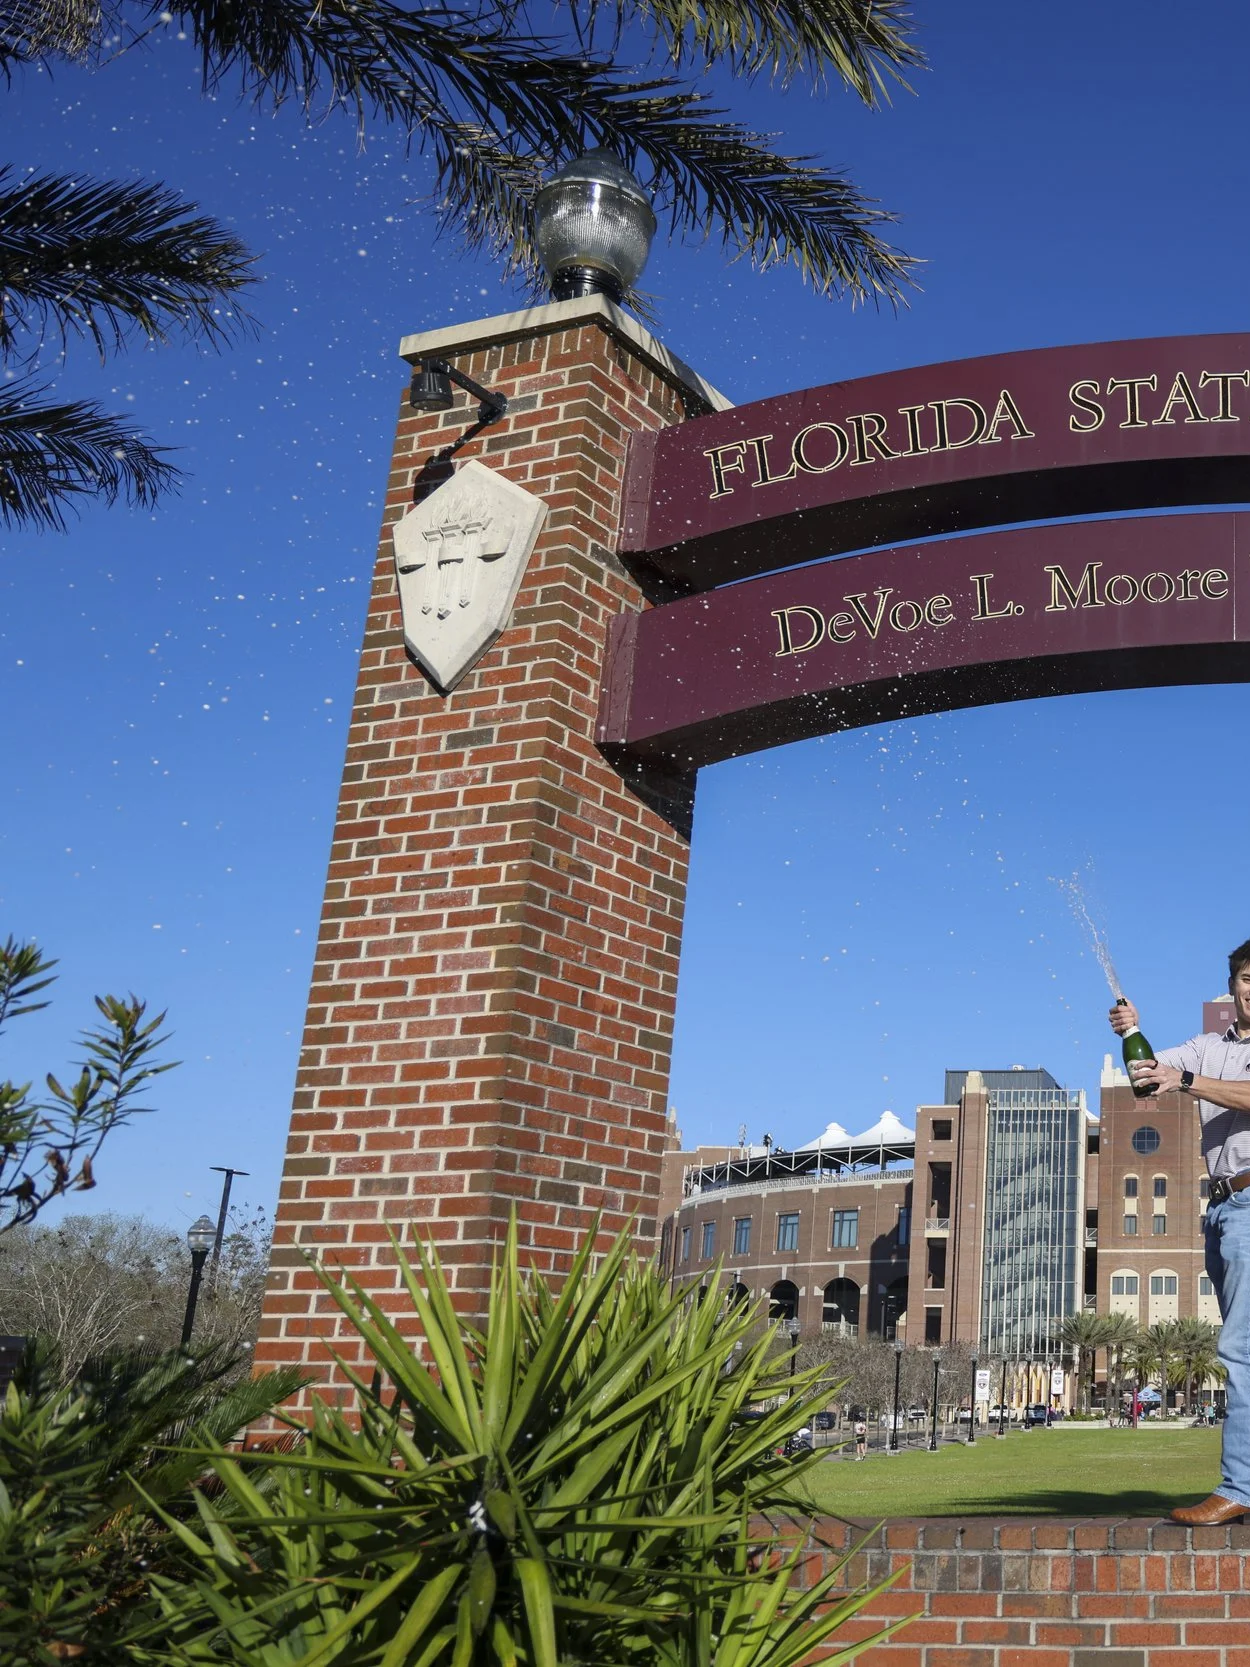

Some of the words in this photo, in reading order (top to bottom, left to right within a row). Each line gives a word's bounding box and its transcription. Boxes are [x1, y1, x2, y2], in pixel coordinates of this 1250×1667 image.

[704, 390, 1034, 499] FLORIDA
[771, 587, 954, 657] DeVoe
[970, 573, 1024, 620] L.
[1045, 563, 1228, 611] Moore
